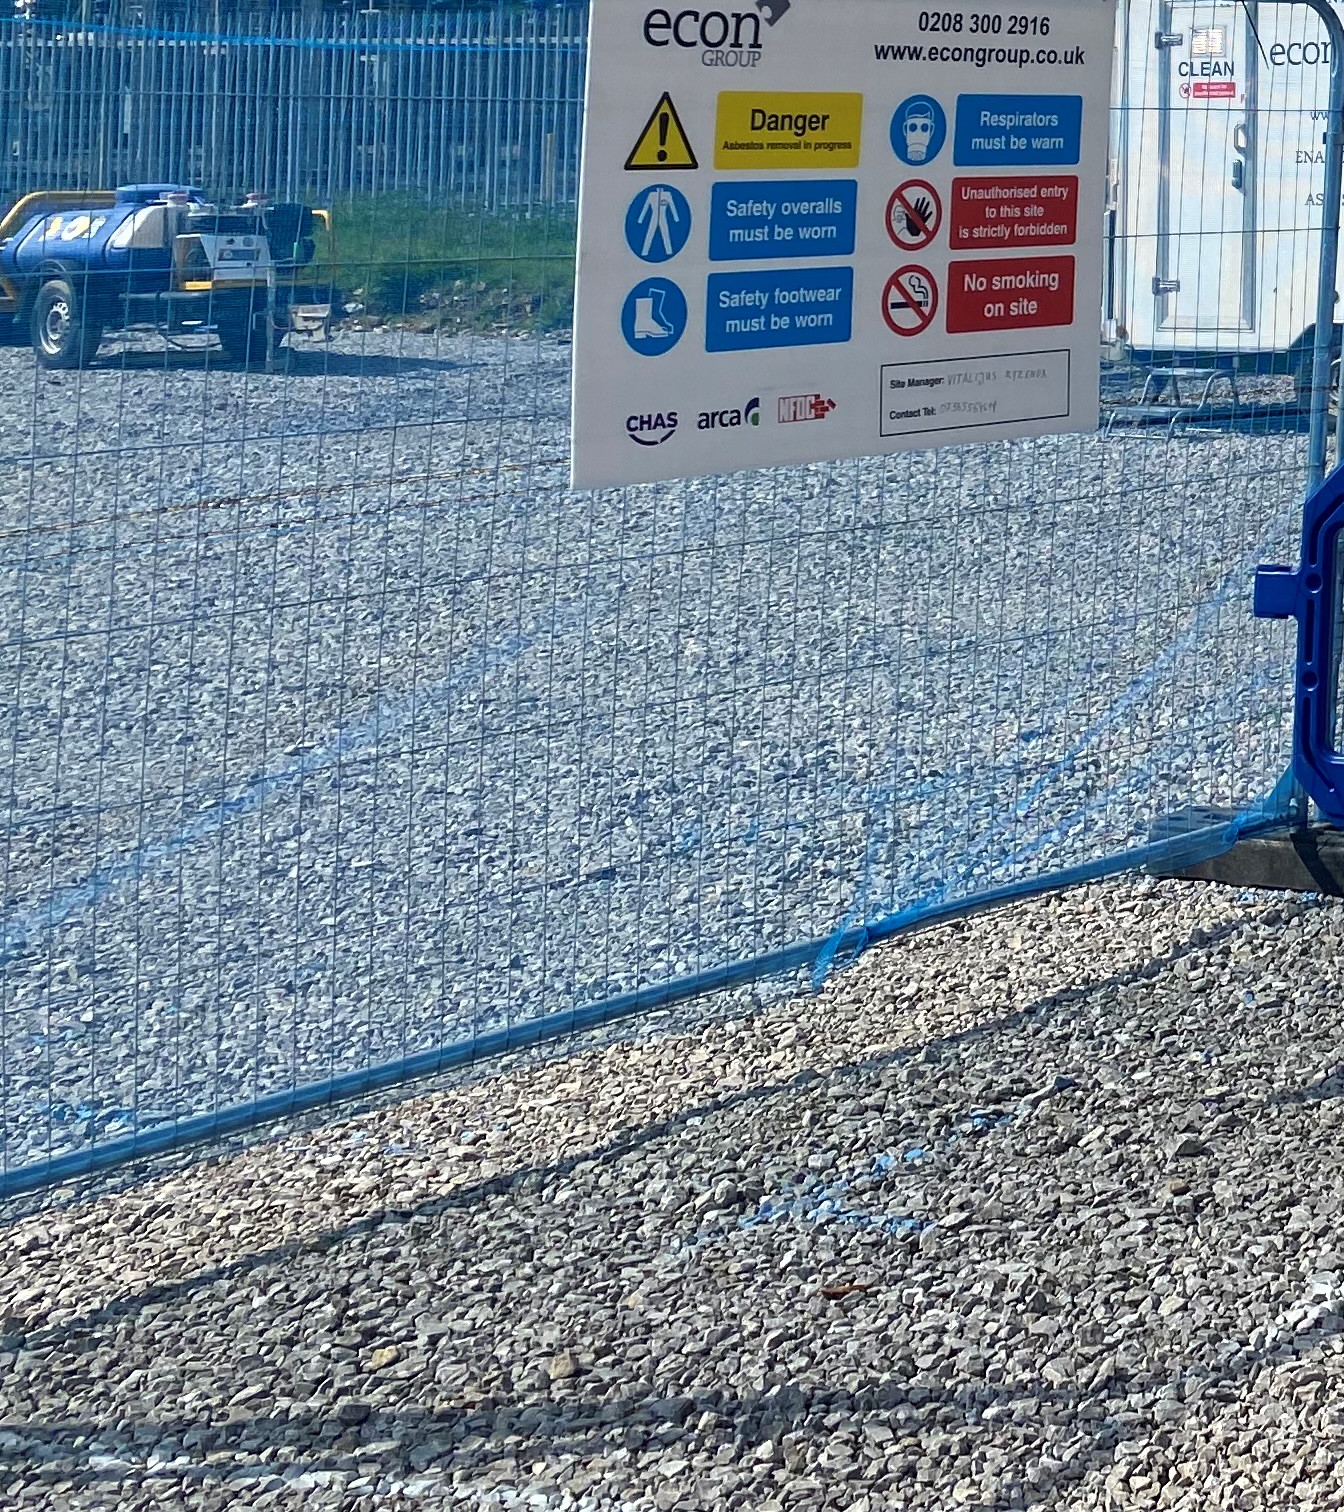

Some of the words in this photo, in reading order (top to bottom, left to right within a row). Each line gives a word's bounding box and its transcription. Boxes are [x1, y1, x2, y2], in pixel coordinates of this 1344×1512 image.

[643, 8, 762, 49] econ
[918, 12, 963, 33] 0208
[969, 14, 1001, 34] 300
[1007, 15, 1050, 36] 2916
[702, 50, 761, 68] GROUP
[874, 44, 1085, 68] www.econgroup.co.uk
[1178, 61, 1234, 76] CLEAN
[751, 108, 830, 137] Danger
[980, 110, 1058, 130] Respirators
[722, 140, 764, 150] Asbestos
[766, 140, 802, 150] removal
[804, 140, 812, 150] in
[814, 141, 852, 152] progress
[972, 135, 1006, 150] must
[1010, 134, 1027, 150] be
[961, 185, 1038, 200] Unauthorised
[1040, 186, 1068, 200] entry
[726, 200, 776, 220] Safety
[782, 198, 842, 214] overalls
[985, 206, 996, 218] to
[1000, 204, 1020, 218] this
[1024, 204, 1044, 217] site
[729, 225, 770, 242] must
[774, 224, 794, 240] be
[798, 225, 836, 239] worn
[959, 226, 968, 238] is
[972, 224, 1010, 240] strictly
[1014, 222, 1068, 236] forbidden
[964, 273, 986, 292] No
[992, 270, 1060, 291] smoking
[719, 290, 769, 309] Safety
[774, 286, 842, 304] footwear
[984, 302, 1004, 318] on
[1010, 298, 1038, 316] site
[726, 314, 766, 332] must
[770, 314, 790, 330] be
[795, 313, 832, 328] worn
[890, 379, 906, 389] Site
[908, 377, 944, 388] Manager:
[626, 411, 678, 433] CHAS
[697, 408, 741, 430] arca
[890, 409, 921, 420] Contact
[922, 406, 936, 416] Tel:
